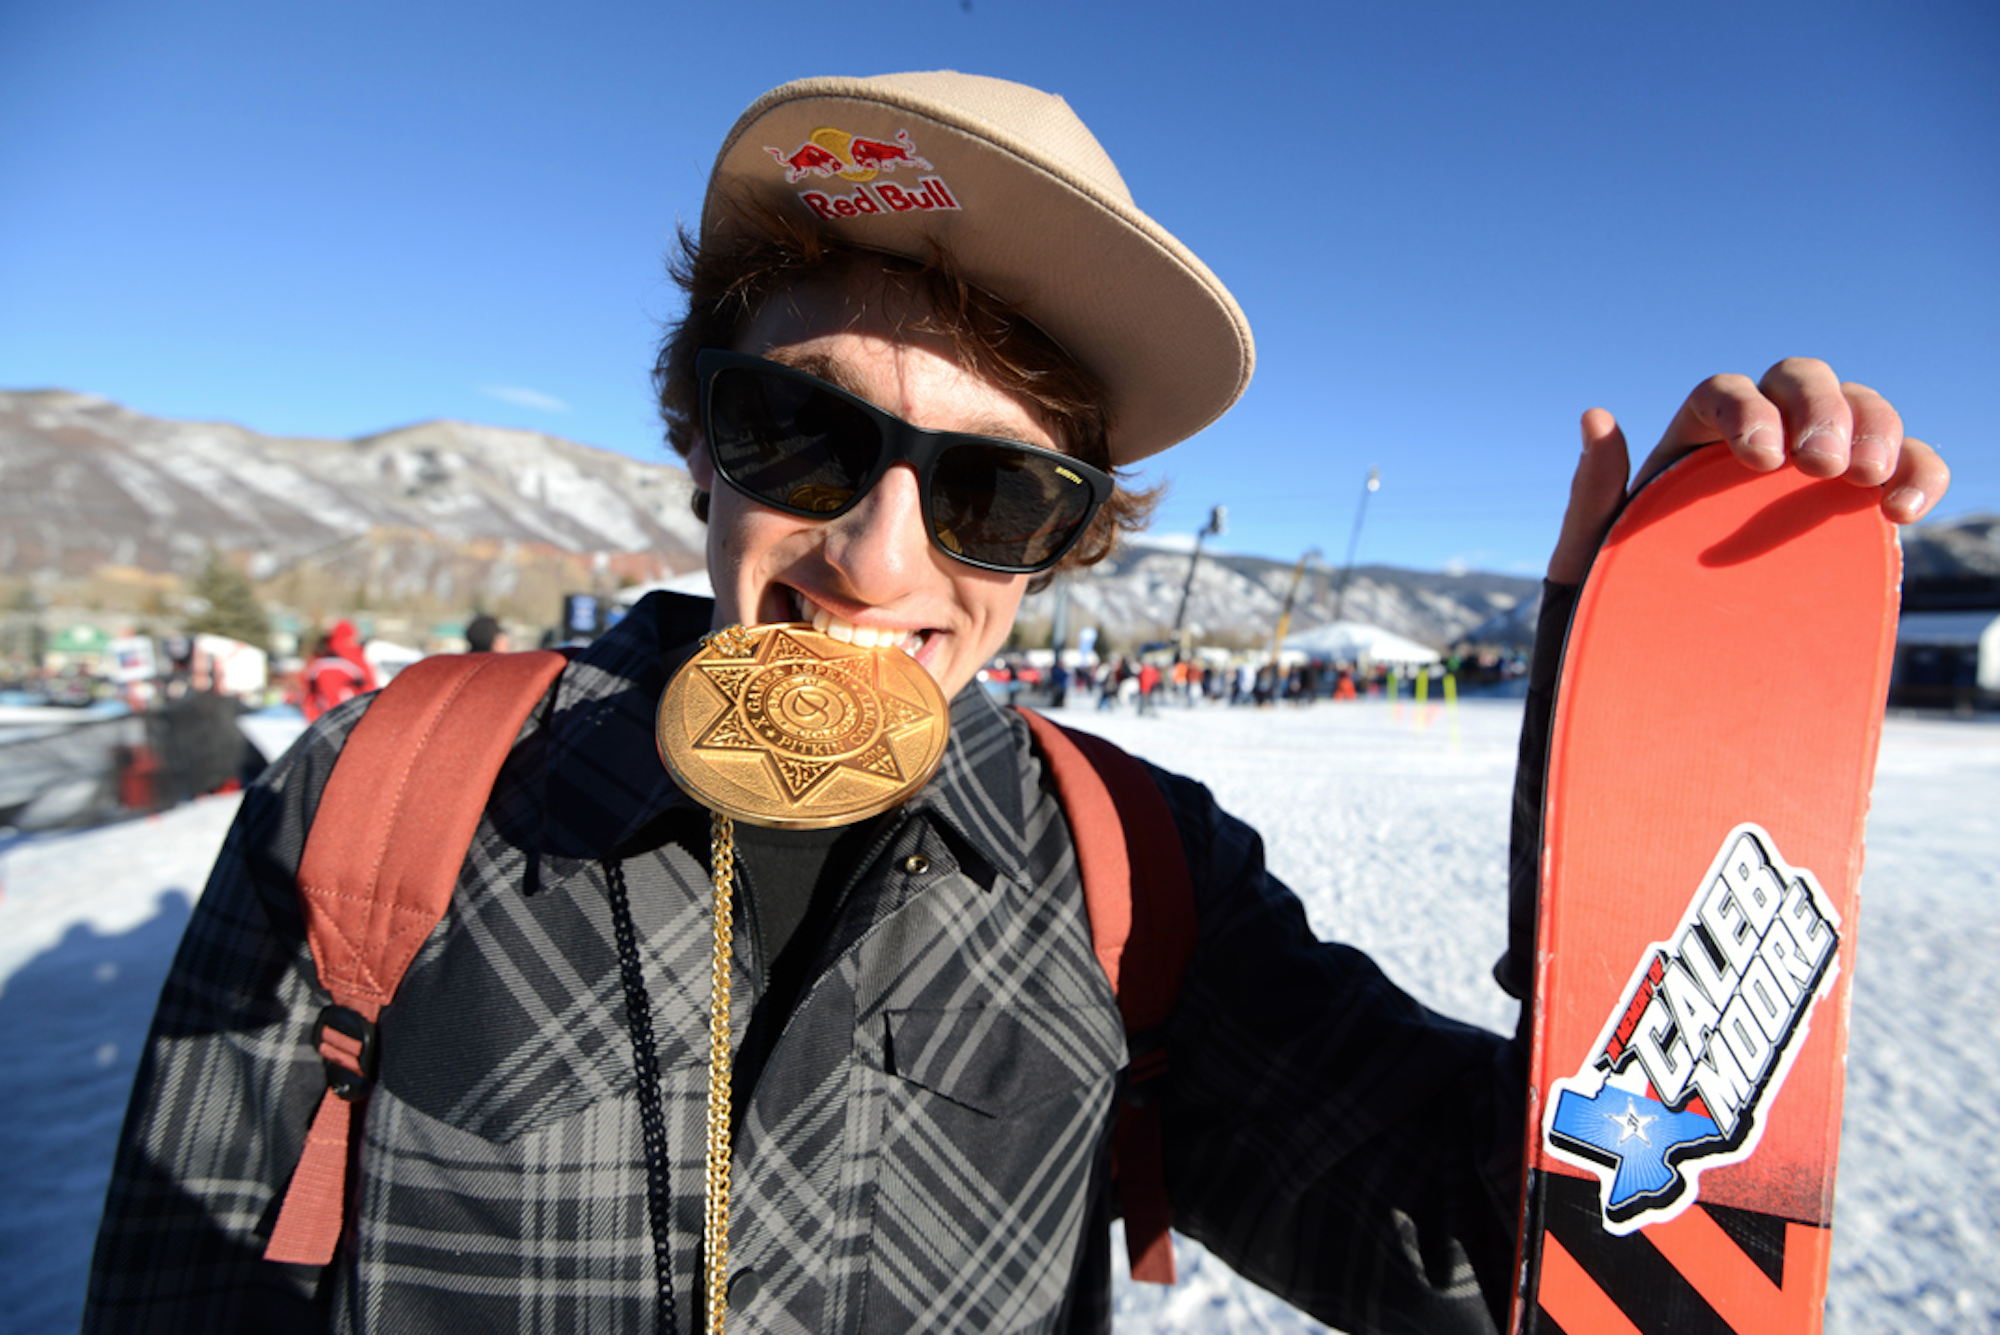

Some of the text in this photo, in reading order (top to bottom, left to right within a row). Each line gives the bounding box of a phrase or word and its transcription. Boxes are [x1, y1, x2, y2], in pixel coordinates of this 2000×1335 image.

[800, 177, 959, 221] Red Bull
[746, 668, 784, 713] GAMES
[791, 664, 848, 684] ASPEN
[751, 715, 769, 728] X
[778, 735, 845, 755] PITKIN
[849, 692, 876, 745] COUNTY
[857, 744, 887, 768] 2014
[1631, 833, 1785, 1106] CALEB
[1605, 956, 1665, 1063] IN MEMORY OF
[1696, 877, 1837, 1140] MOORE
